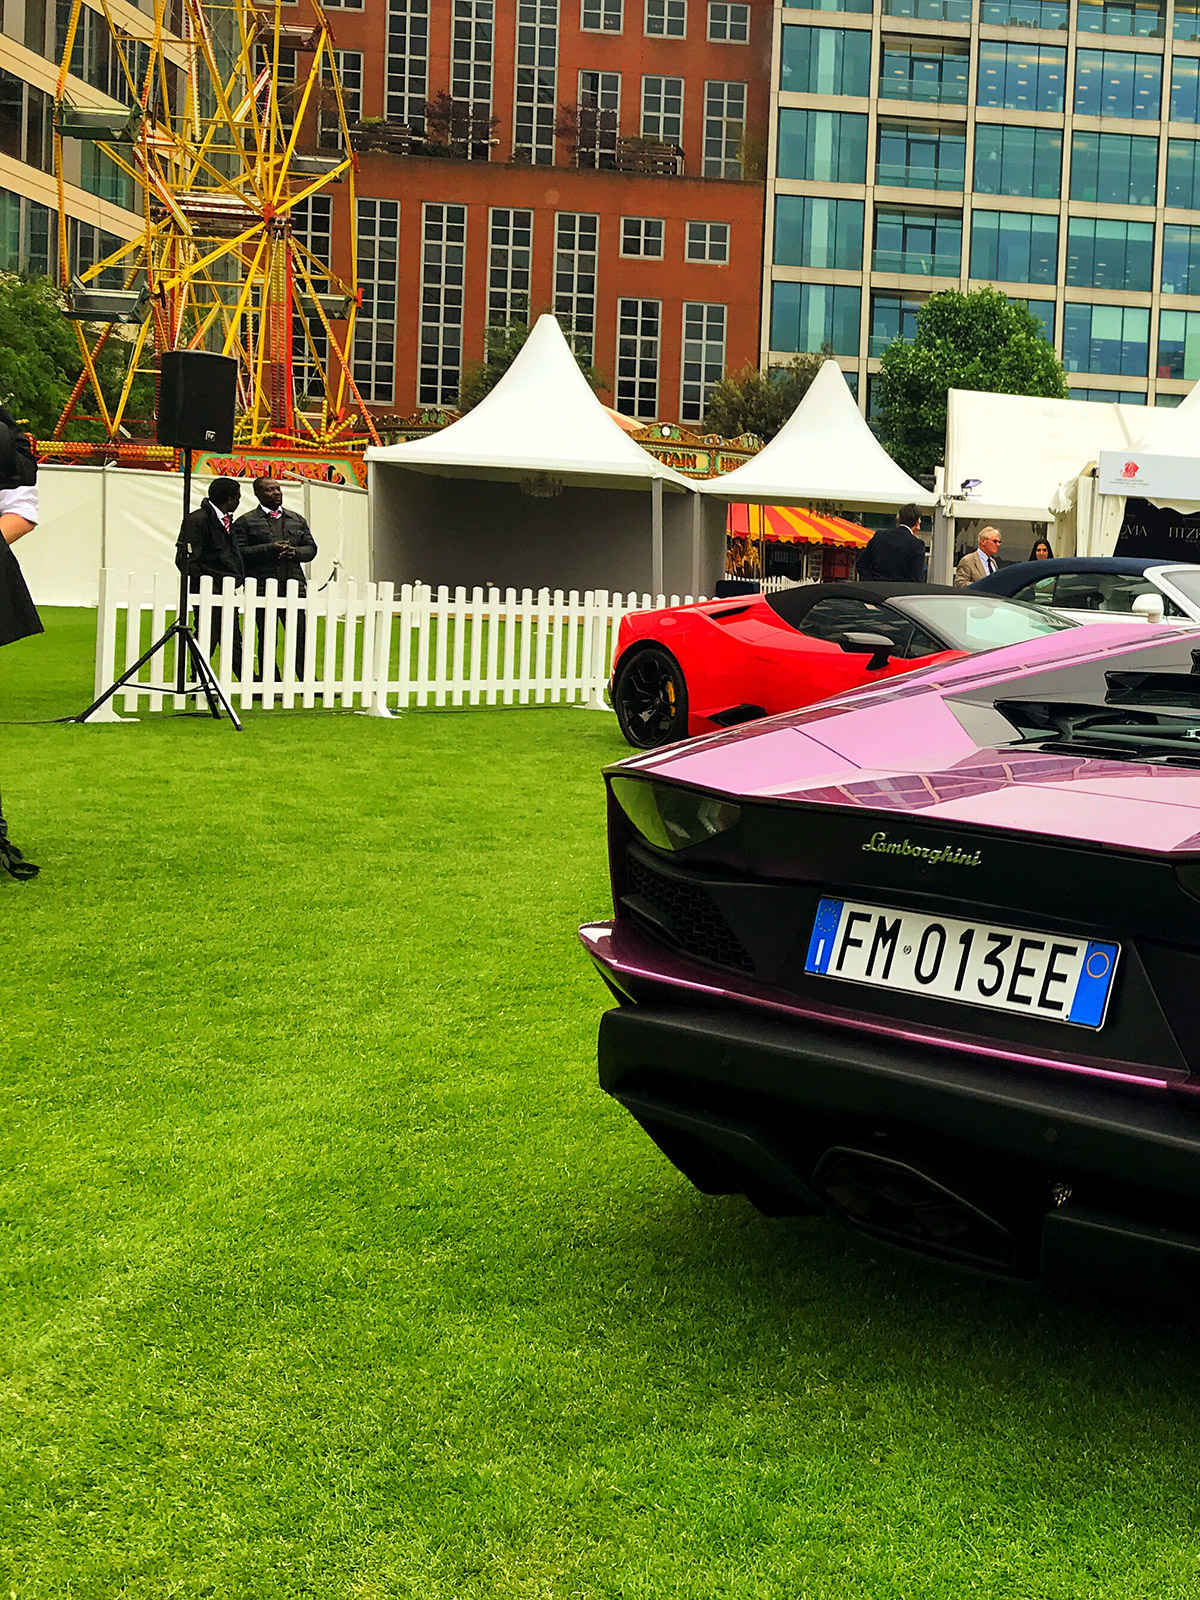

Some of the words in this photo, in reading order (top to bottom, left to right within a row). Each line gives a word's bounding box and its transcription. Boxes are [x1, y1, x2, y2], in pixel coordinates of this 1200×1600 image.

[205, 455, 346, 485] WHEEL
[1120, 524, 1148, 537] OVIA
[861, 831, 982, 867] Lamborghini
